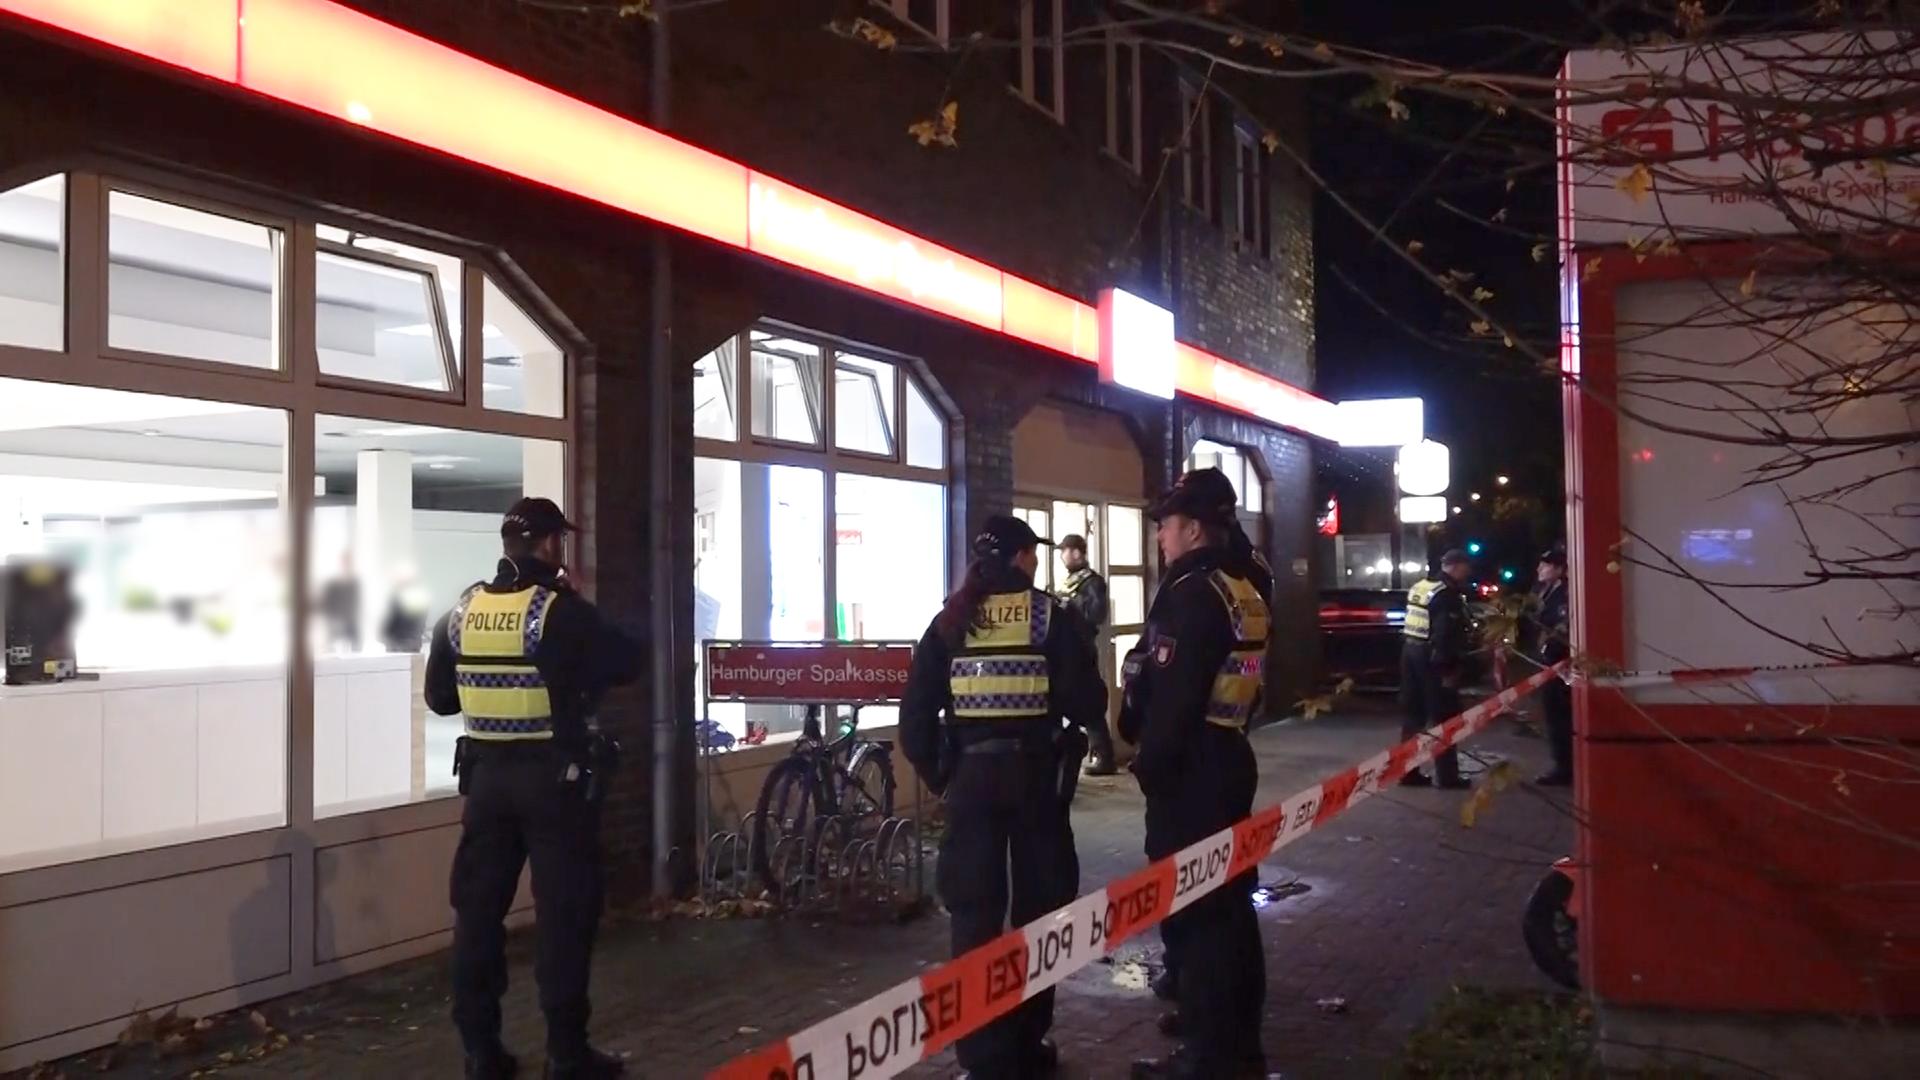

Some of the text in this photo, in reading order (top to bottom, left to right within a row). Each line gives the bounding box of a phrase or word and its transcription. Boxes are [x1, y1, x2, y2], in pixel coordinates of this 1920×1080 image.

[466, 612, 521, 631] POLIZEI
[711, 662, 908, 685] Hamburger Sparkasse
